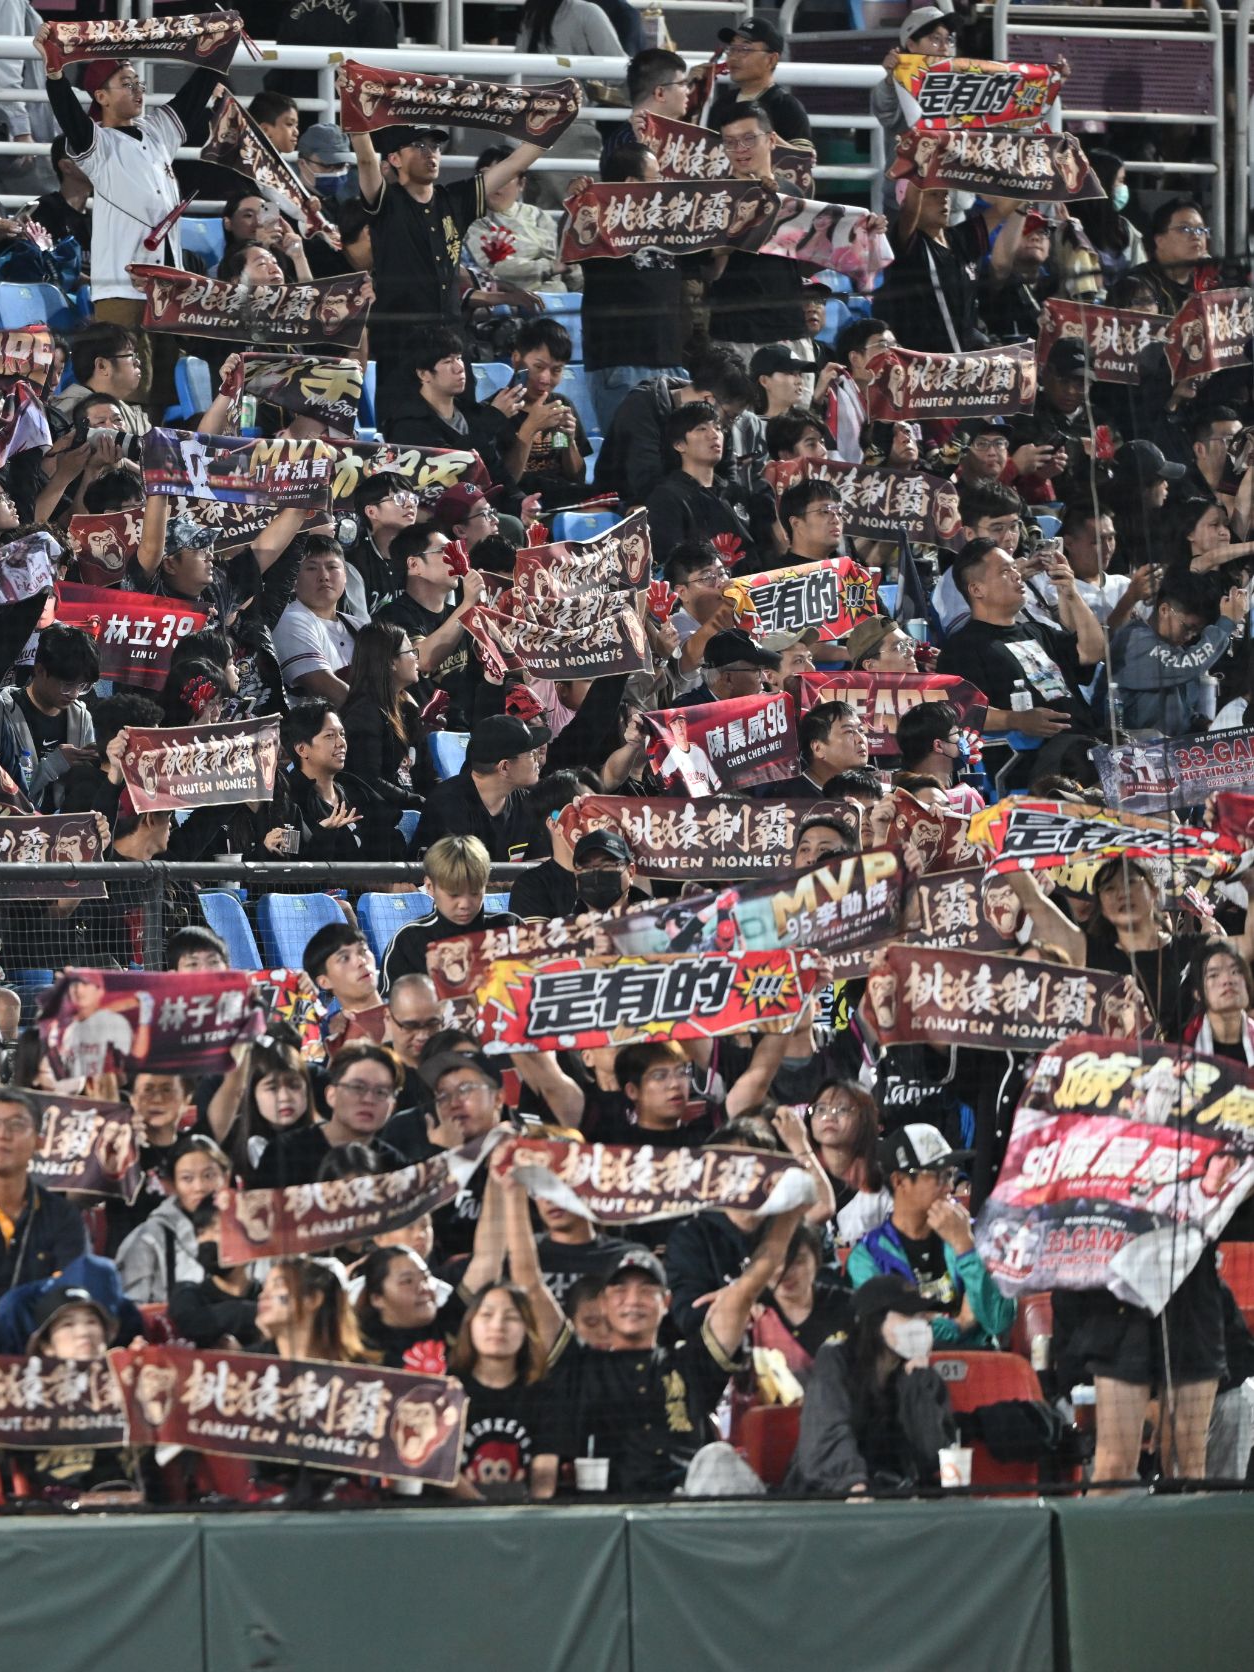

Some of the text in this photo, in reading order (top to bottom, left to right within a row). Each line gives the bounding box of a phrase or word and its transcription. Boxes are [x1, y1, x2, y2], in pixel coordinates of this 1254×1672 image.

[137, 41, 187, 52] MONKEYS
[916, 71, 1021, 116] 是有的
[387, 105, 514, 126] RAKUTEN MONKEYS
[939, 131, 1056, 178] 桃猿制霸
[936, 168, 1053, 191] RAKUTEN MONKEYS
[602, 190, 733, 233] 桃猿制霸
[177, 278, 320, 322] 桃猿制霸
[178, 312, 240, 329] RAKUTEN
[908, 353, 1016, 396] 桃猿制霸
[908, 392, 1010, 409] RAKUTEN MONKEYS
[273, 458, 330, 482] 林泓育
[858, 516, 925, 532] MONKEYS
[130, 649, 158, 660] LIN LI
[564, 650, 624, 667] MONKEYS
[161, 731, 256, 781] 桃猿制霸
[726, 740, 783, 768] CHEN CHEN-WEI
[169, 777, 258, 797] RAKUTEN MONKEYS
[1179, 764, 1234, 783] HITTING
[621, 801, 797, 852] 桃猿制霸
[712, 853, 792, 868] MONKEYS
[770, 849, 899, 939] MVP
[529, 956, 738, 1037] 是有的
[906, 959, 1099, 1028] 桃猿制霸
[912, 1015, 994, 1035] RAKUTEN
[560, 1143, 766, 1204] 桃猿制霸
[181, 1357, 392, 1440] 桃猿制霸
[187, 1417, 380, 1460] RAKUTEN MONKEYS
